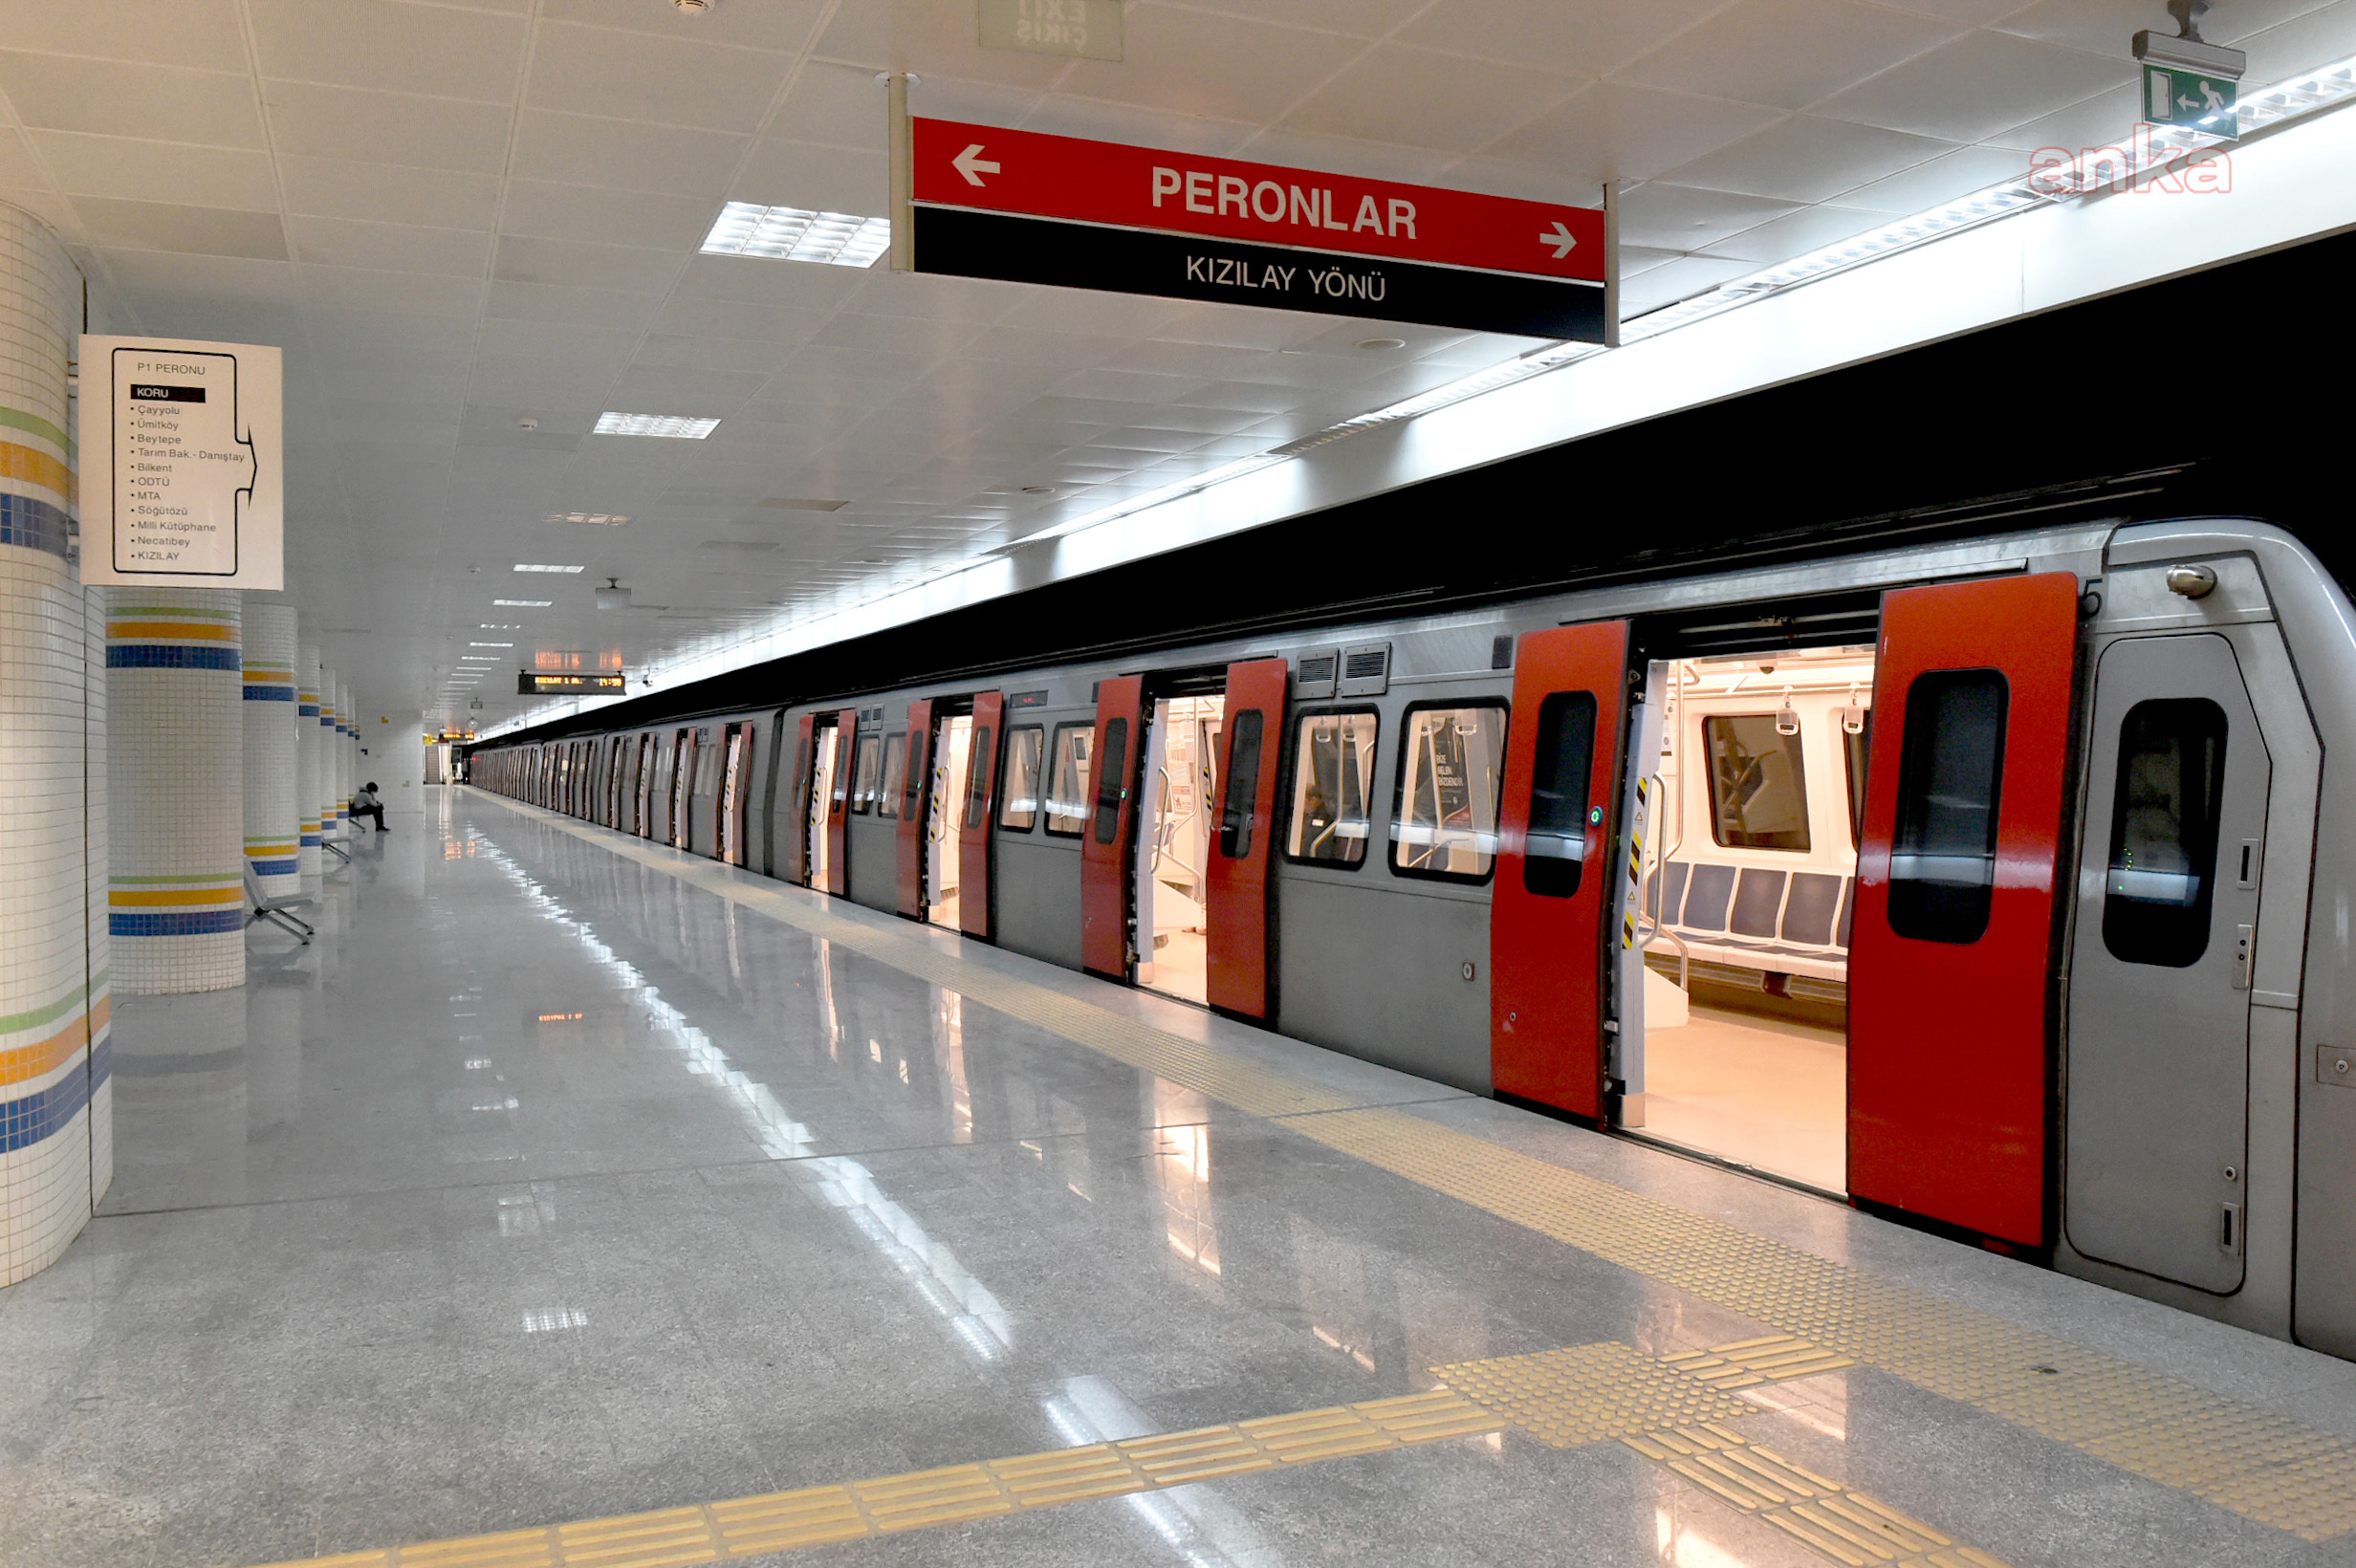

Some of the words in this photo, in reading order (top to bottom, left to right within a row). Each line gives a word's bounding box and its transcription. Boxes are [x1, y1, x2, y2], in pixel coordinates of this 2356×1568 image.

[1151, 165, 1418, 240] PERONLAR
[1186, 255, 1298, 292] KIZILAY
[1308, 267, 1386, 302] YÖNÜ
[138, 362, 151, 372] P1
[156, 363, 206, 375] PERONU
[137, 387, 169, 399] KORU
[138, 405, 181, 416] Çayyolu
[138, 418, 179, 431] Ümitköy
[138, 434, 182, 446] Beytepe
[139, 447, 166, 457] Tarım
[199, 450, 245, 463] Danıştay
[138, 463, 172, 472] Bilkent
[138, 476, 170, 487] ODTÜ
[138, 491, 161, 500] MTA
[138, 505, 188, 516] Söğütözü
[138, 521, 157, 530] Milli
[160, 521, 216, 533] Kütüphane
[138, 536, 190, 548] Necatibey
[138, 551, 180, 560] KIZILAY
